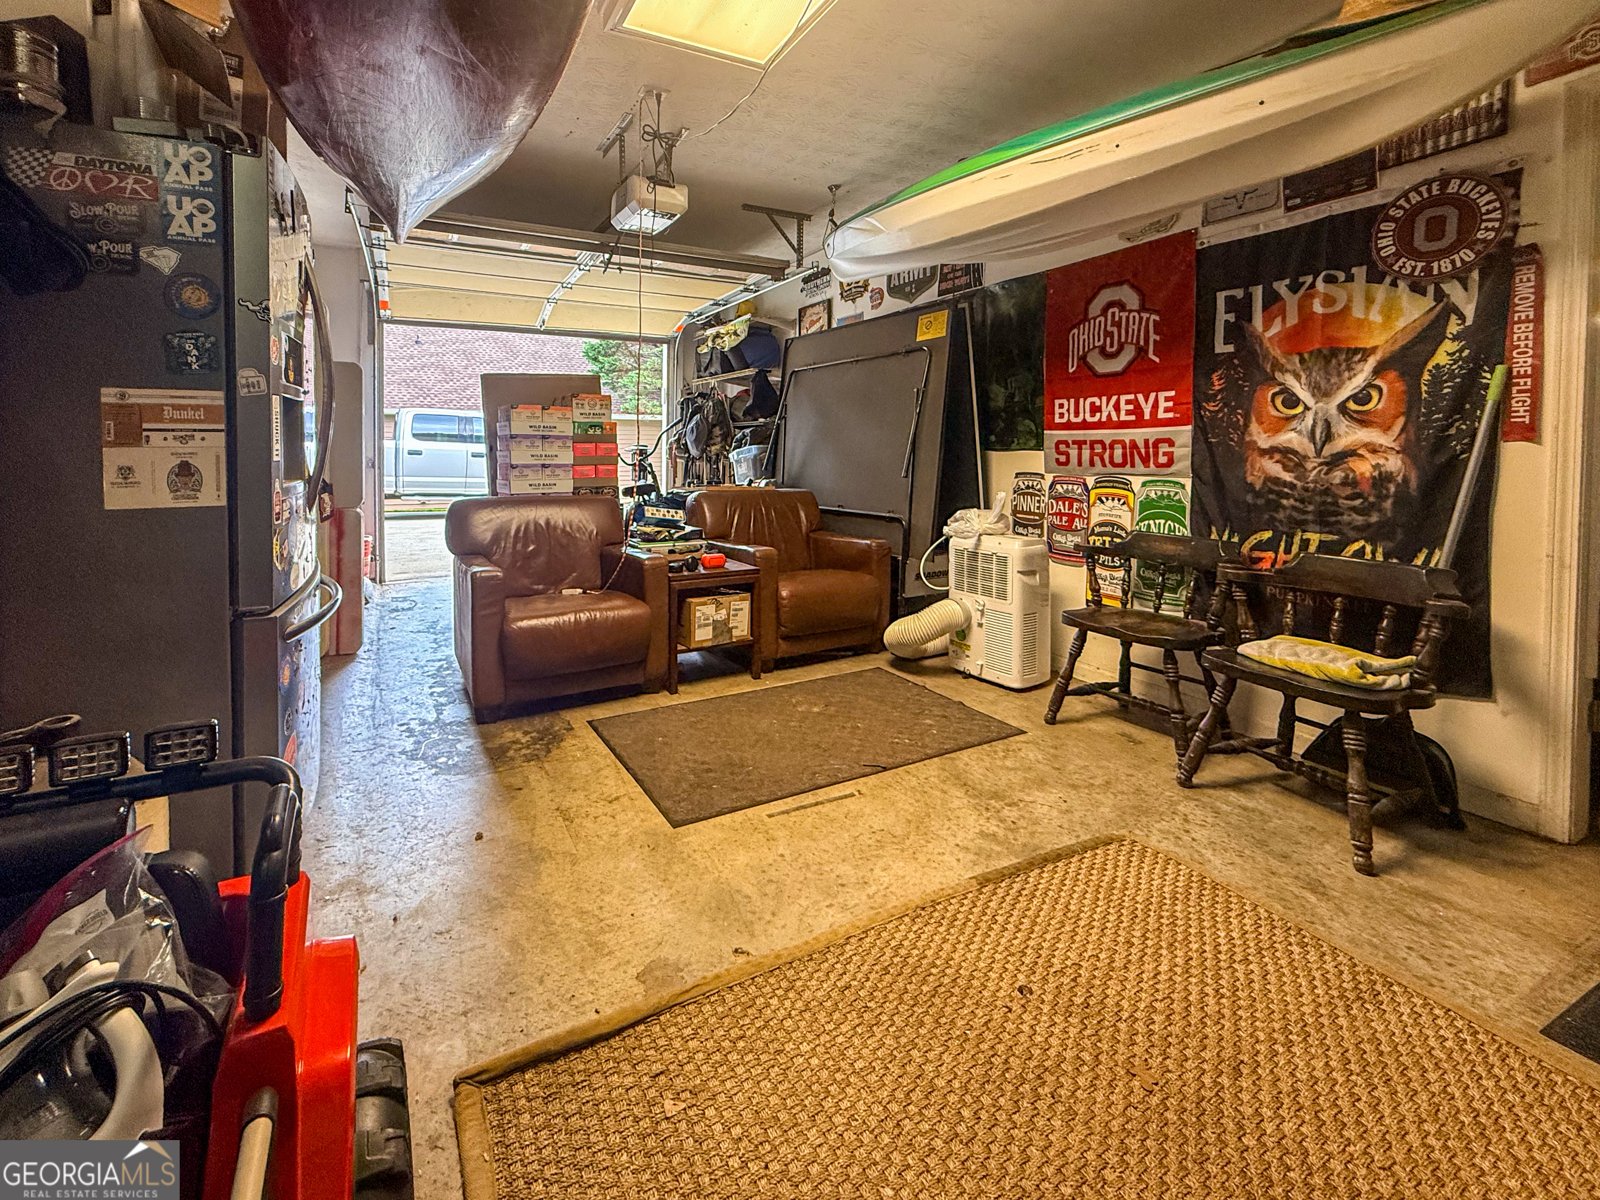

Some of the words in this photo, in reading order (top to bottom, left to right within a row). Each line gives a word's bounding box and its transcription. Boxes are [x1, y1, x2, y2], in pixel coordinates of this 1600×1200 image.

[74, 156, 153, 175] DAYTONA
[1377, 222, 1396, 257] OHIO
[1389, 181, 1440, 218] STATE
[1446, 179, 1502, 240] BUCKEYES
[1392, 258, 1426, 277] EST.
[1431, 248, 1476, 275] 1870
[1513, 265, 1536, 321] REMOVE
[185, 343, 200, 370] DANK
[1511, 325, 1534, 376] BEFORE
[162, 406, 205, 420] Dunkel
[1054, 391, 1176, 424] BUCKEYE
[1510, 378, 1531, 424] FLIGHT
[1054, 437, 1176, 469] STRONG
[1012, 494, 1046, 514] PINNER
[1048, 499, 1088, 518] DALE'S
[1048, 515, 1068, 526] PALE
[1072, 517, 1088, 530] ALE
[1099, 554, 1120, 566] PILS
